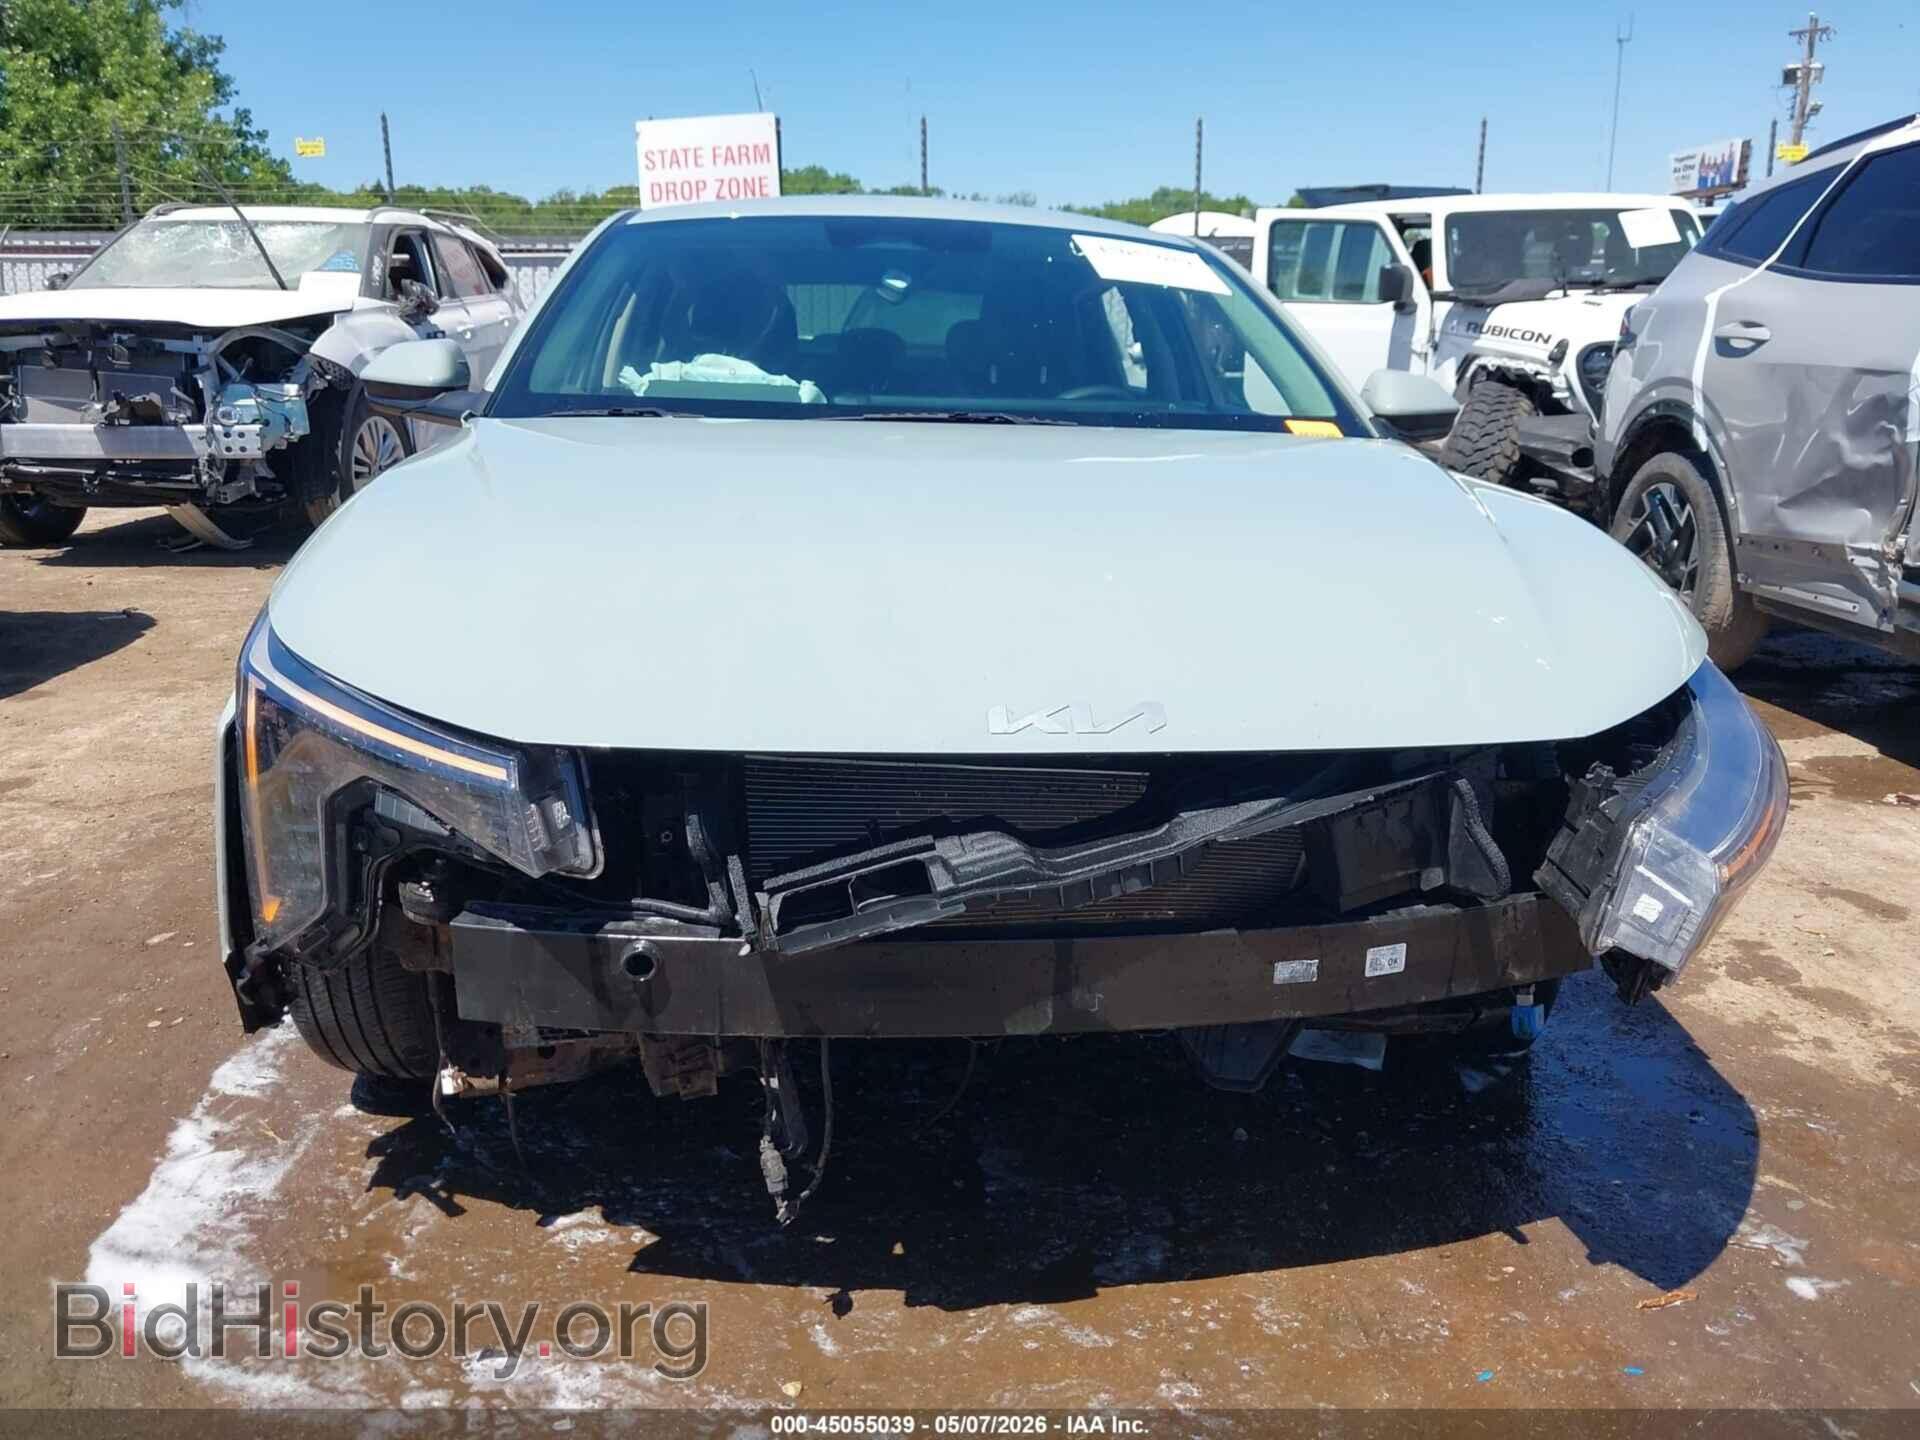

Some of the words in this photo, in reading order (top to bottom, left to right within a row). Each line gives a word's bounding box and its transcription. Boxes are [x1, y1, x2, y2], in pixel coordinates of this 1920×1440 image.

[644, 147, 705, 171] STATE
[712, 143, 771, 166] FARM
[650, 179, 707, 203] DROP
[714, 175, 769, 200] ZONE
[1465, 321, 1553, 345] RUBICON
